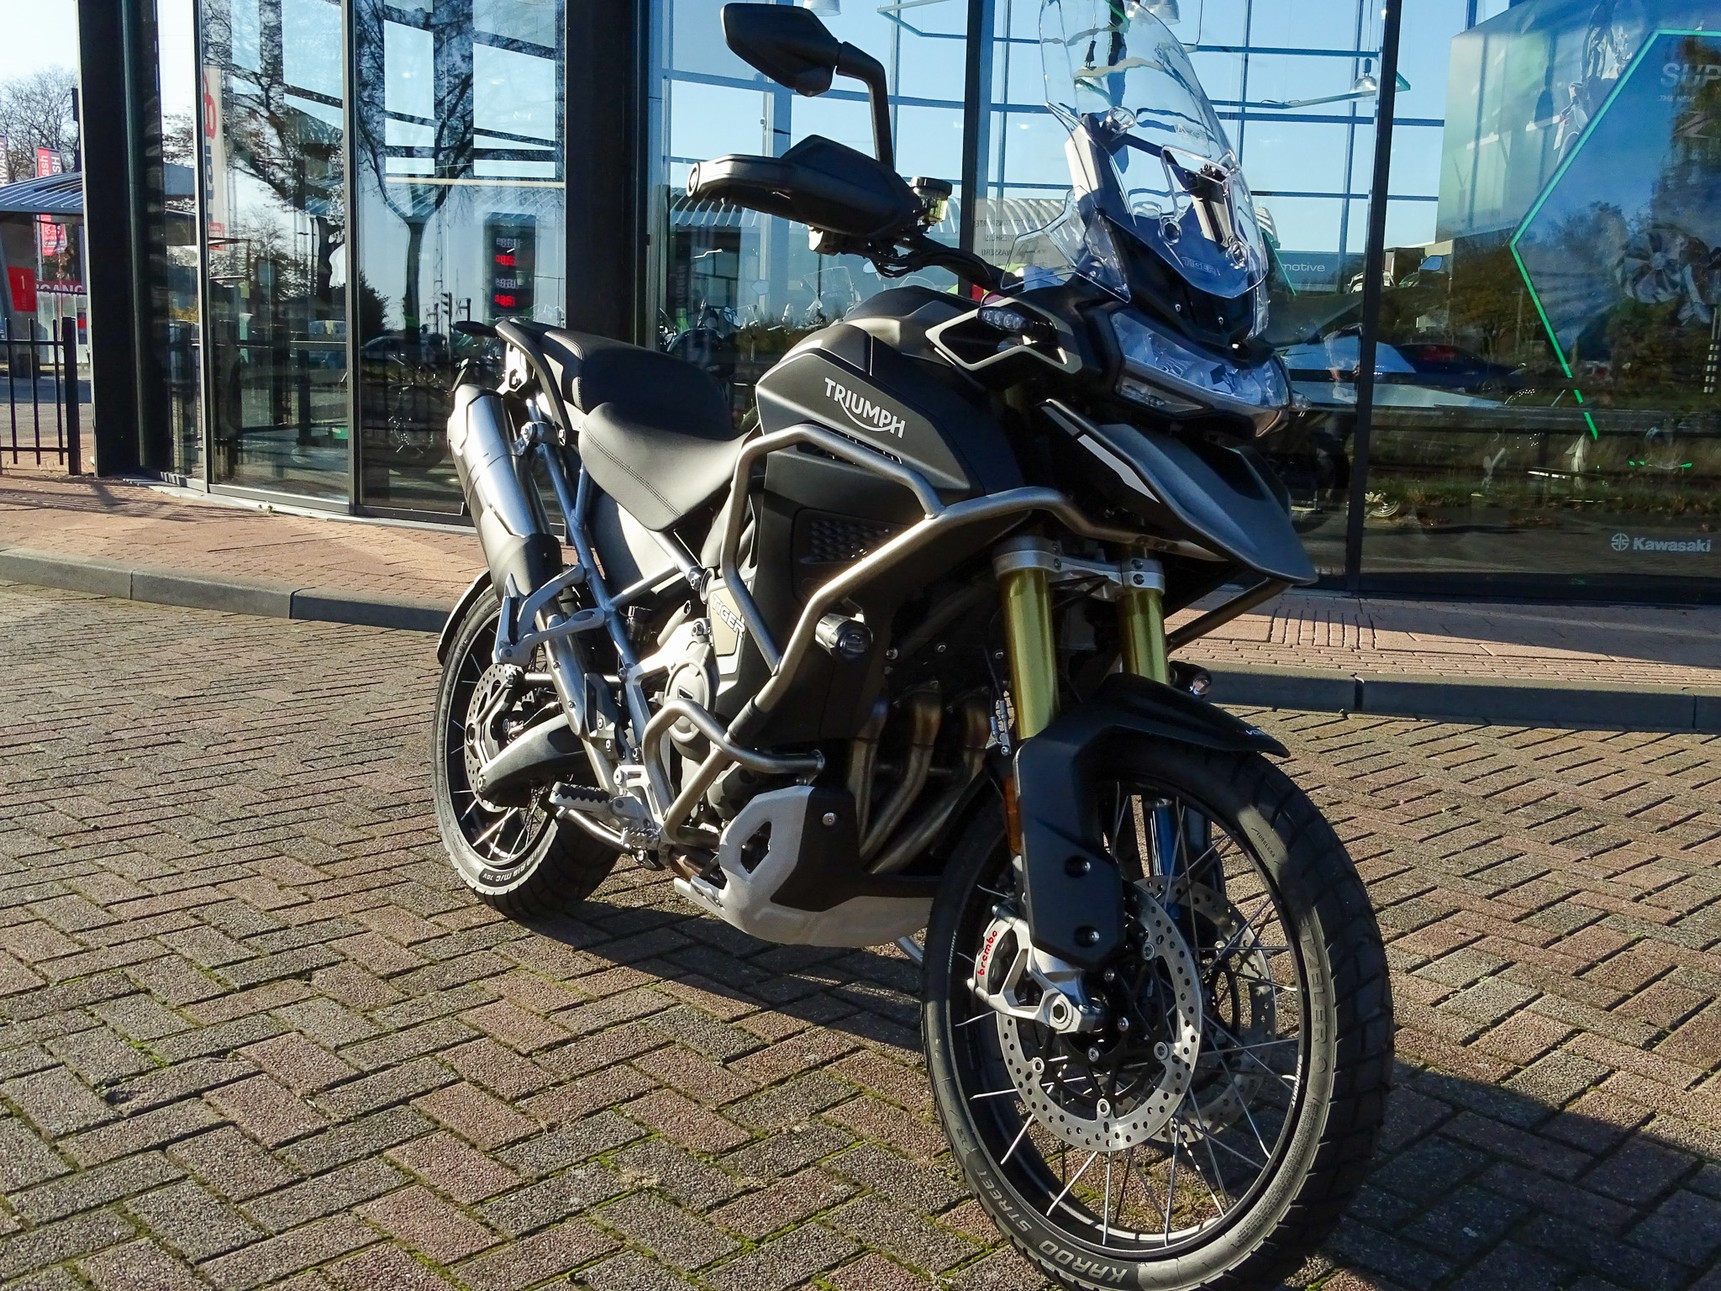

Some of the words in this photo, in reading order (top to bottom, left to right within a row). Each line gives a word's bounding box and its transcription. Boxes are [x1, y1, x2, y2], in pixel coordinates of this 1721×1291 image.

[825, 377, 906, 439] TRIUMPH
[1632, 537, 1711, 552] Kawasaki
[711, 593, 746, 638] TIGER
[977, 930, 998, 976] brembo
[974, 1169, 1033, 1233] STREET
[1038, 1240, 1128, 1283] KAROO
